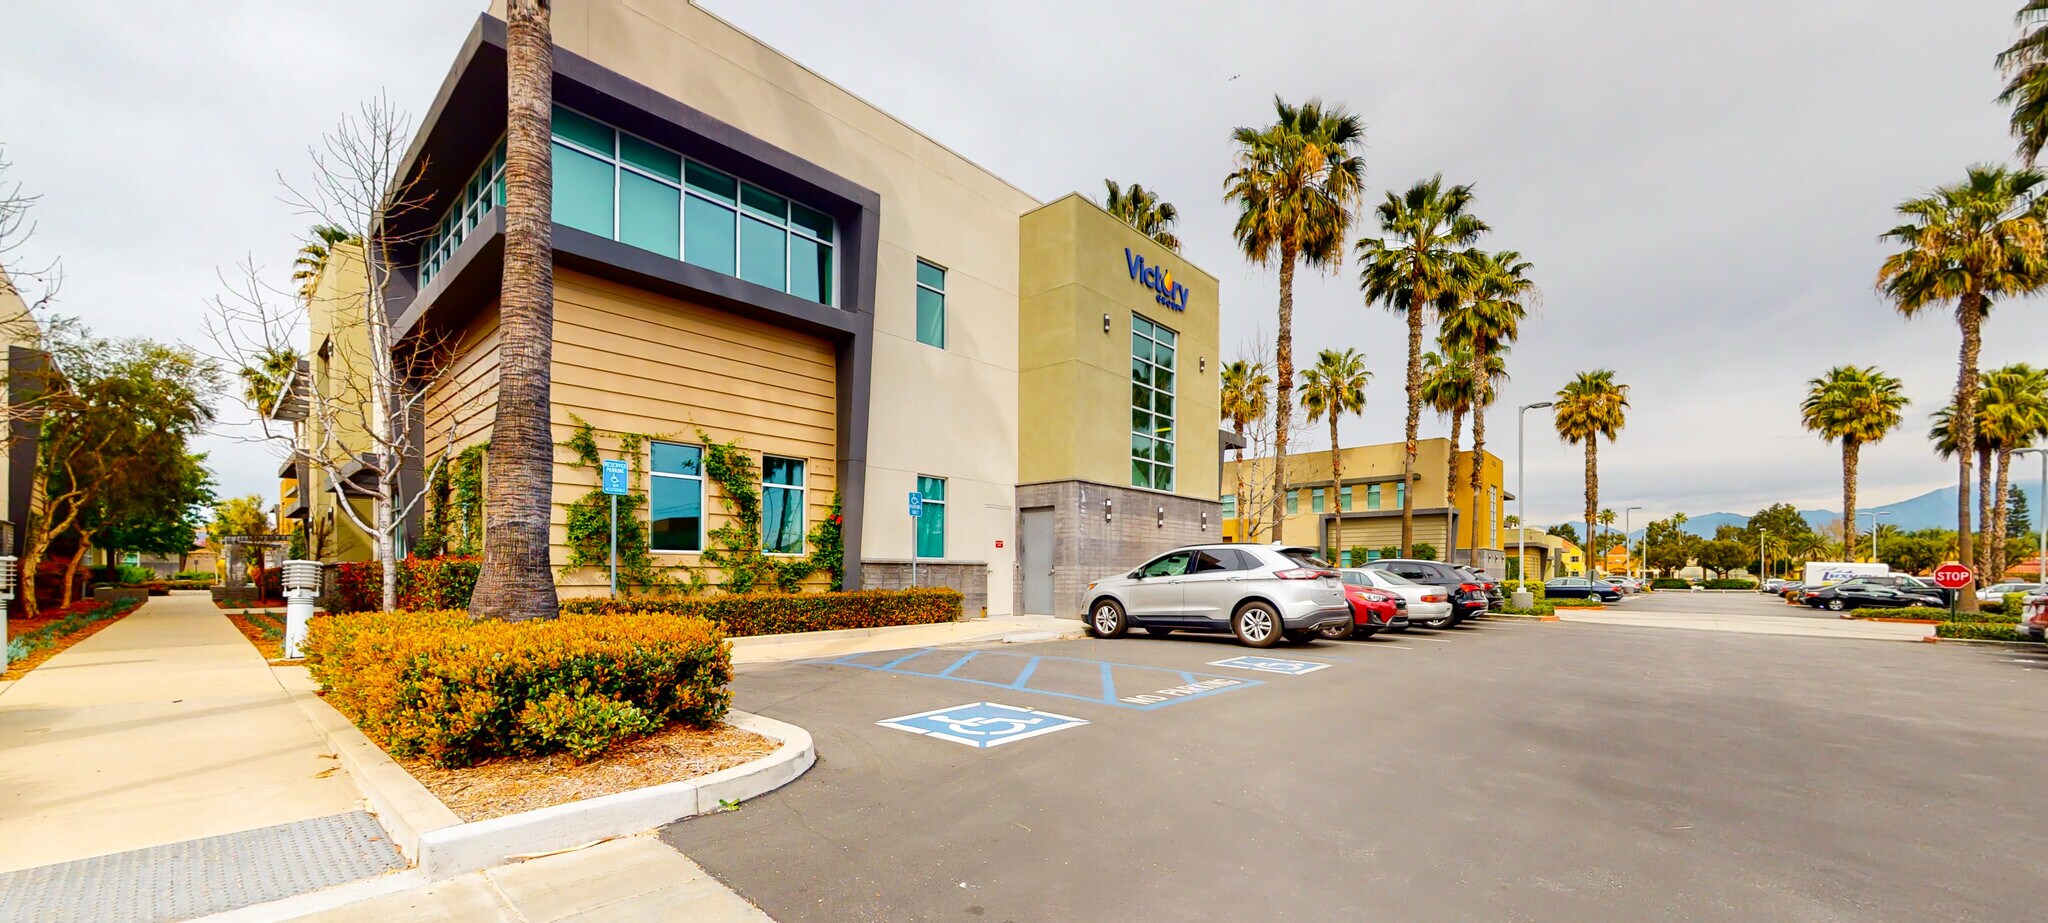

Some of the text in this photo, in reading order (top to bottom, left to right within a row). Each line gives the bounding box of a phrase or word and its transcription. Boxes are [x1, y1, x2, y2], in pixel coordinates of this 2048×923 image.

[1125, 247, 1189, 311] Victory
[604, 461, 627, 469] RESERVED
[1936, 571, 1969, 581] STOP
[1118, 678, 1242, 705] NO PARKING
